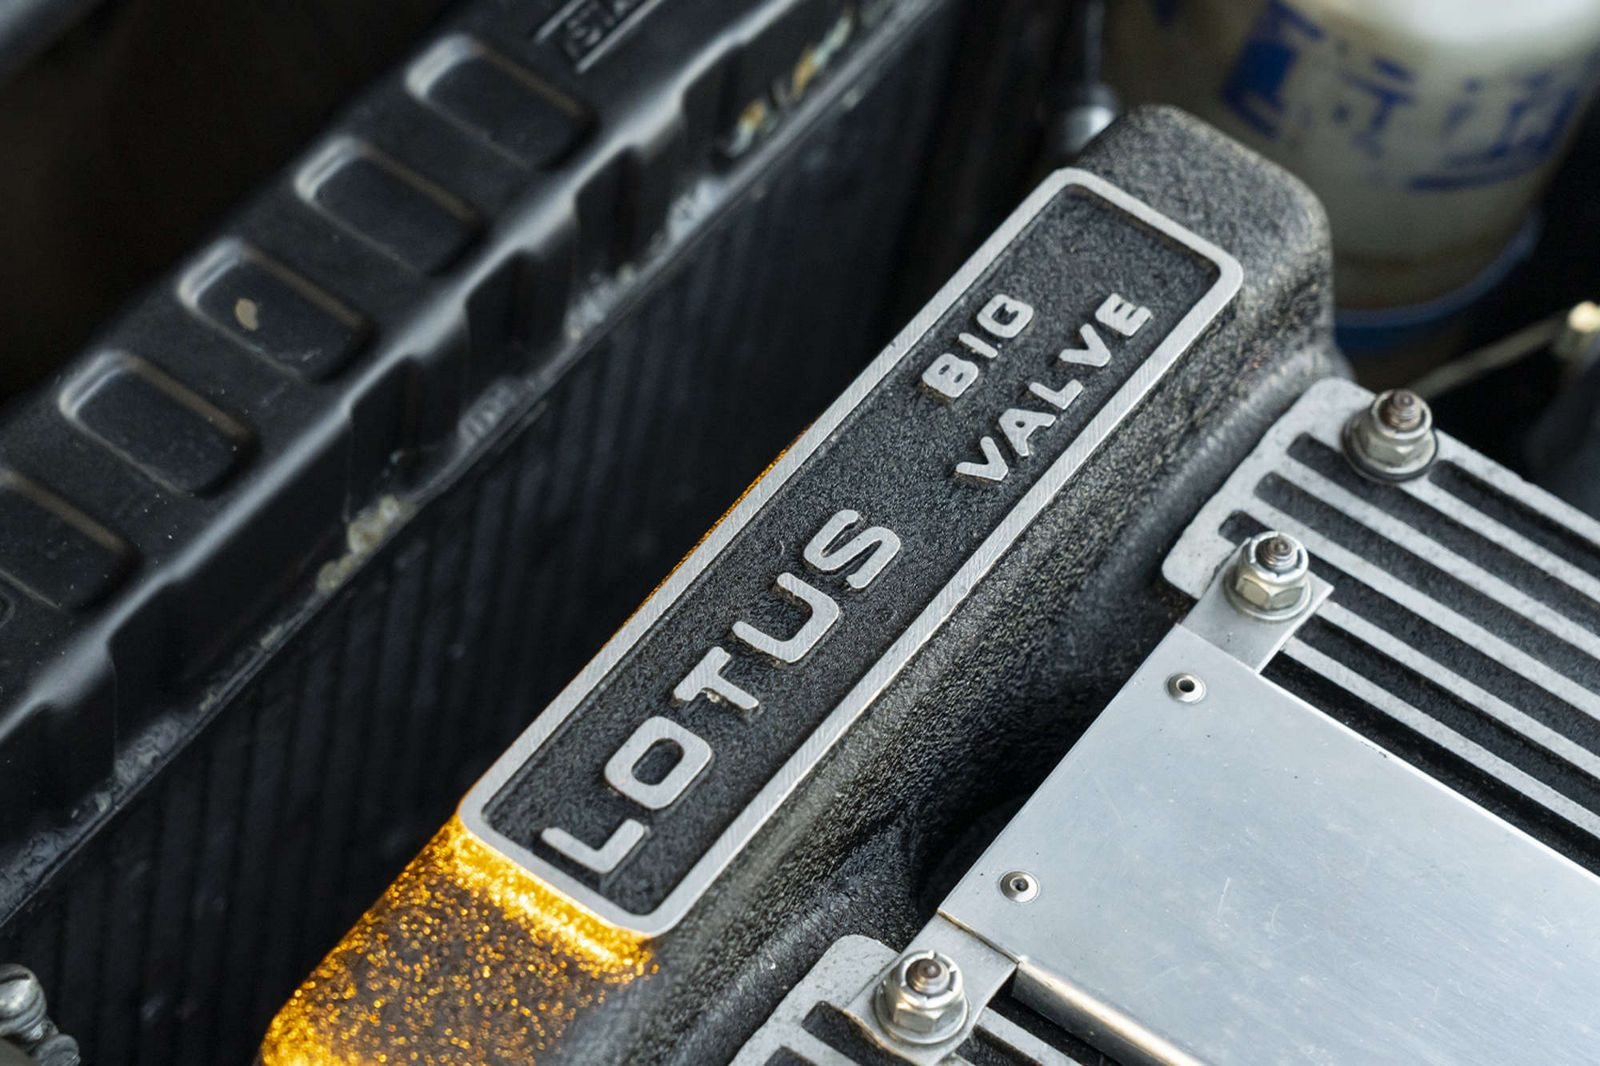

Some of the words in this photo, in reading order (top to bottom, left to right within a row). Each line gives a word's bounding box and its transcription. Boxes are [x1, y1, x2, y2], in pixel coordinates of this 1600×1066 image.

[921, 294, 1034, 398] BIG
[955, 293, 1152, 481] VALVE
[541, 509, 901, 874] LOTUS
